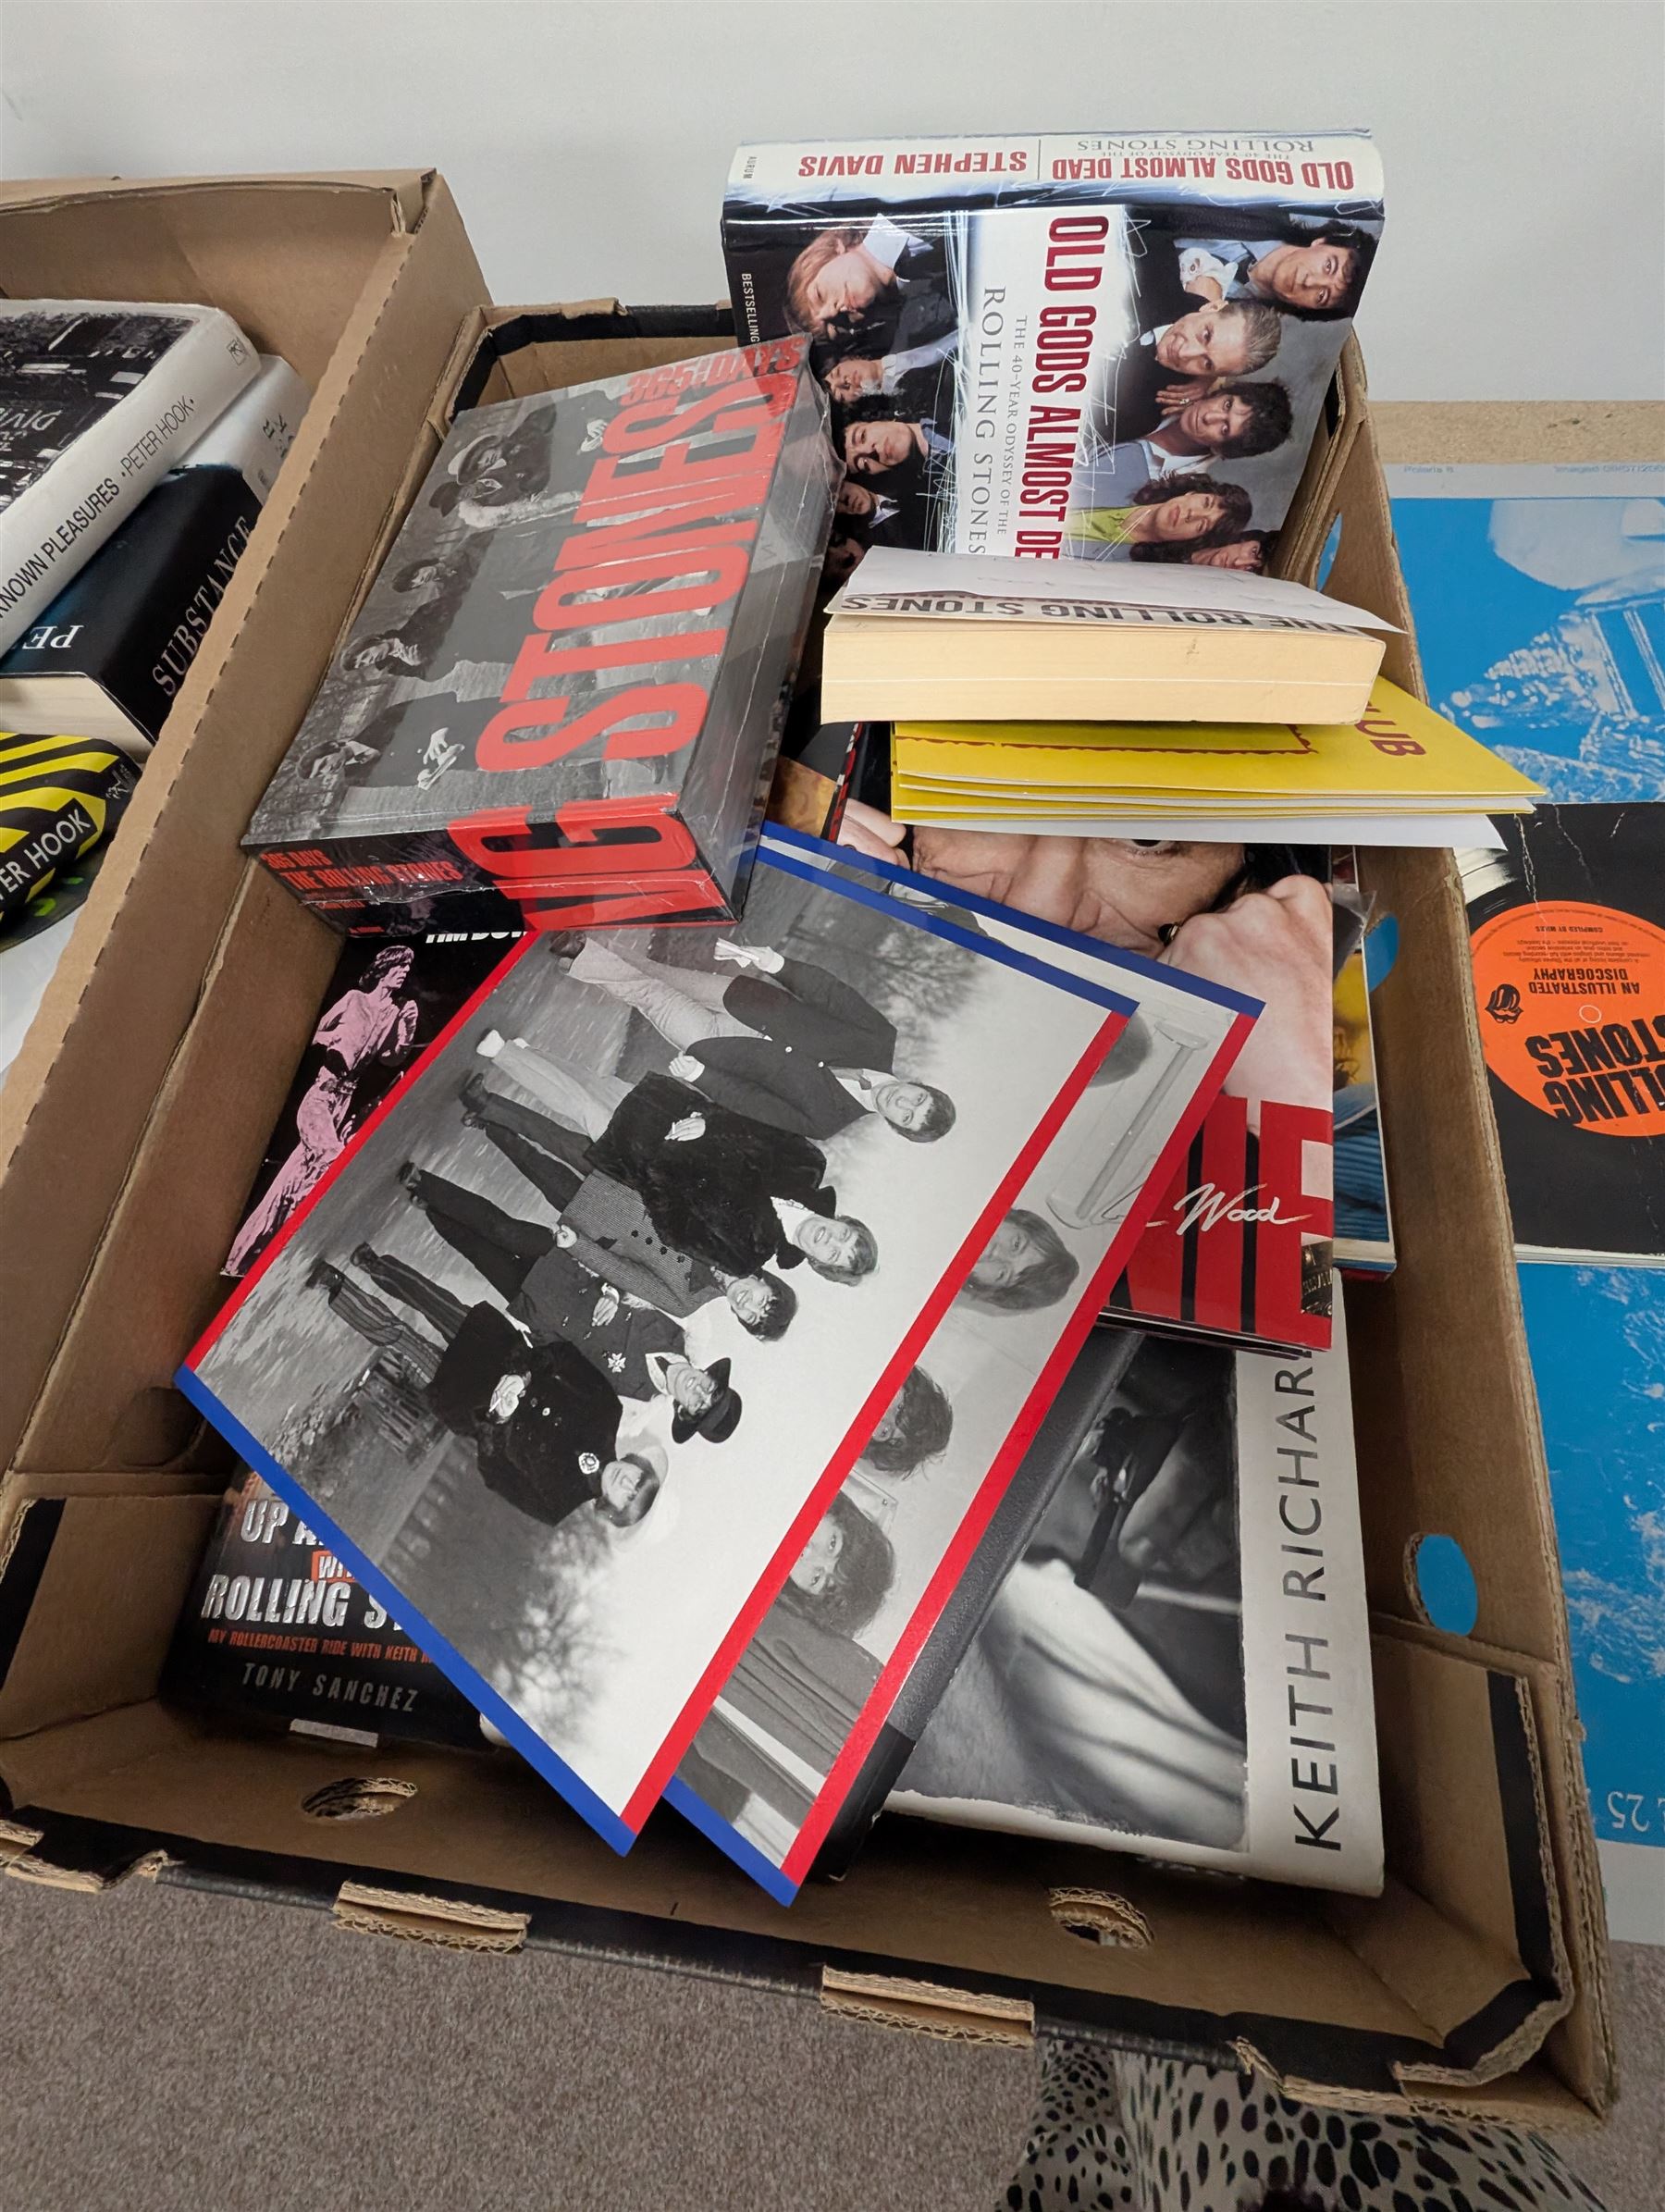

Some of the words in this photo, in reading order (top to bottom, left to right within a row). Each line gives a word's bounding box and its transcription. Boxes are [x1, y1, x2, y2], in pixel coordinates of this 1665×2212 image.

[798, 155, 883, 178] DAVIS
[894, 151, 1027, 174] STEPHEN
[1078, 140, 1176, 151] STONES
[1052, 158, 1110, 180] DEAD
[1120, 156, 1215, 179] ALMOST
[1225, 158, 1294, 185] GODS
[1301, 161, 1354, 190] OLD
[1044, 216, 1109, 291] OLD
[742, 273, 760, 342] BESTSELLING
[1014, 315, 1028, 349] THE
[1031, 305, 1097, 393] GODS
[706, 336, 806, 387] DAYS
[976, 287, 1006, 439] ROLLING
[120, 430, 164, 477] PETER
[156, 395, 193, 440] HOOK
[1002, 423, 1017, 486] ODYSSEY
[1018, 405, 1081, 522] ALMOST
[968, 453, 993, 553] STONES
[1000, 489, 1011, 506] OF
[42, 478, 120, 562] PLEASURES
[997, 511, 1008, 535] THE
[475, 374, 797, 772] STONES
[841, 596, 1023, 615] STONES
[1041, 604, 1253, 625] ROLLING
[1354, 700, 1426, 756] UB
[23, 809, 91, 870] HOOK
[289, 849, 333, 867] DAYS
[278, 870, 323, 889] THE
[1528, 982, 1616, 995] ILLUSTRATED
[1534, 968, 1628, 981] DISCOGRAPHY
[1621, 982, 1640, 994] AN
[1173, 1182, 1314, 1236] Wood
[1275, 1351, 1326, 1601] RICHAR
[240, 1500, 290, 1544] UP
[201, 1573, 352, 1627] ROLLING
[208, 1628, 226, 1644] MY
[229, 1630, 317, 1654] ROLLERCOASTER
[321, 1638, 347, 1656] RIDE
[351, 1642, 381, 1659] WITH
[385, 1645, 417, 1662] KEITH
[242, 1662, 302, 1692] TONY
[313, 1674, 419, 1712] SANCHEZ
[1284, 1632, 1341, 1851] KEITH
[1607, 1790, 1650, 1833] 25
